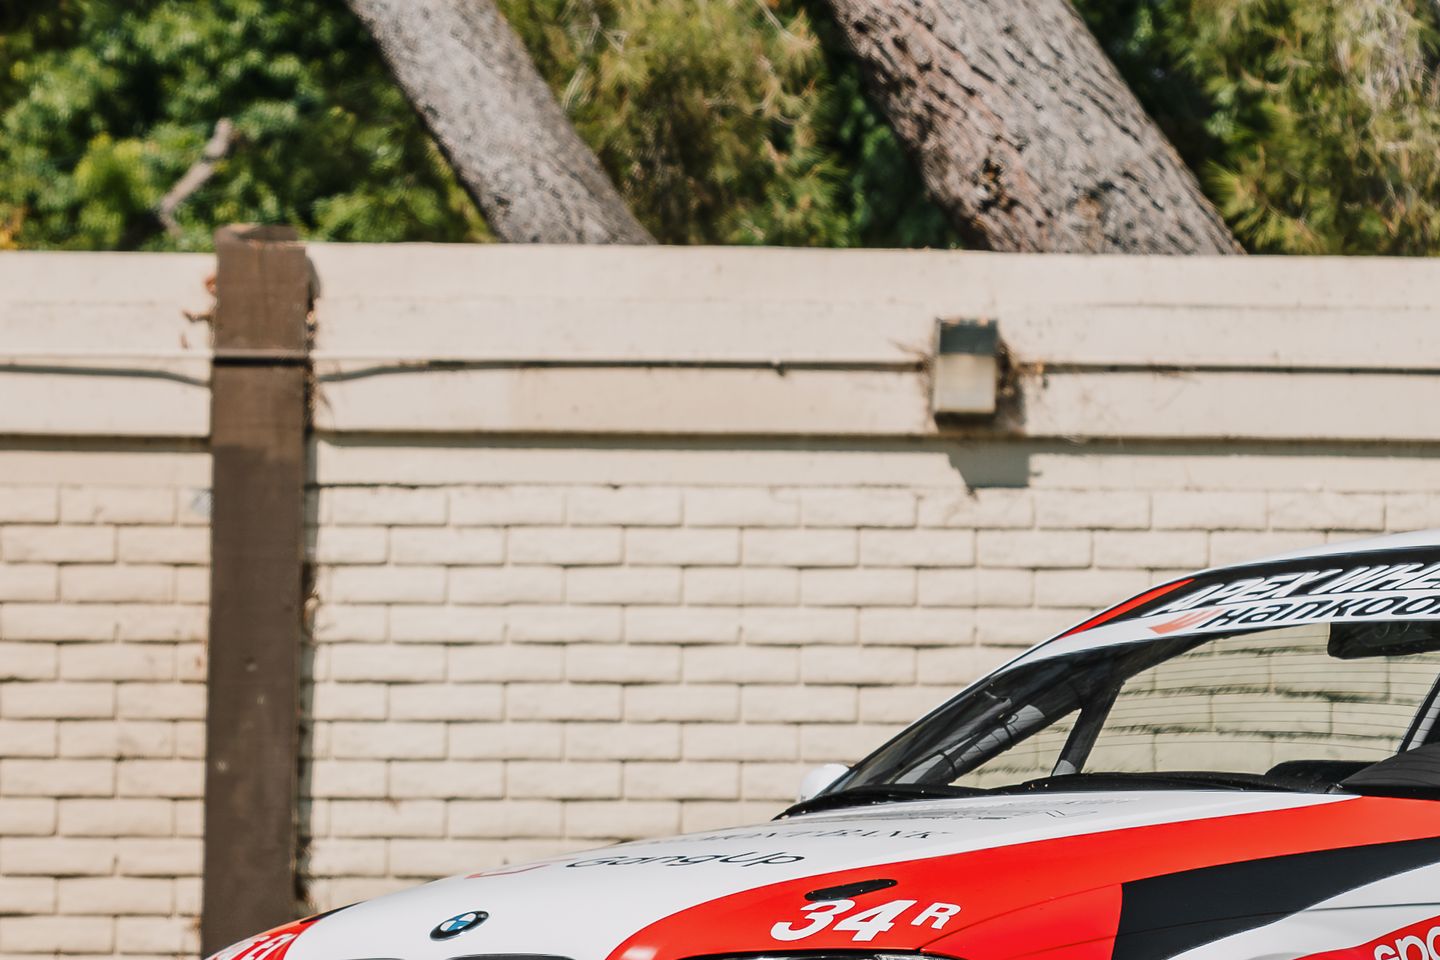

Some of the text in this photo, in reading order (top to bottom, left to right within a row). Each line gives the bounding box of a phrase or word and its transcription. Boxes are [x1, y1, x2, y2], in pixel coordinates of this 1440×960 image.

[1140, 568, 1343, 618] APEX
[770, 899, 962, 942] 34 R
